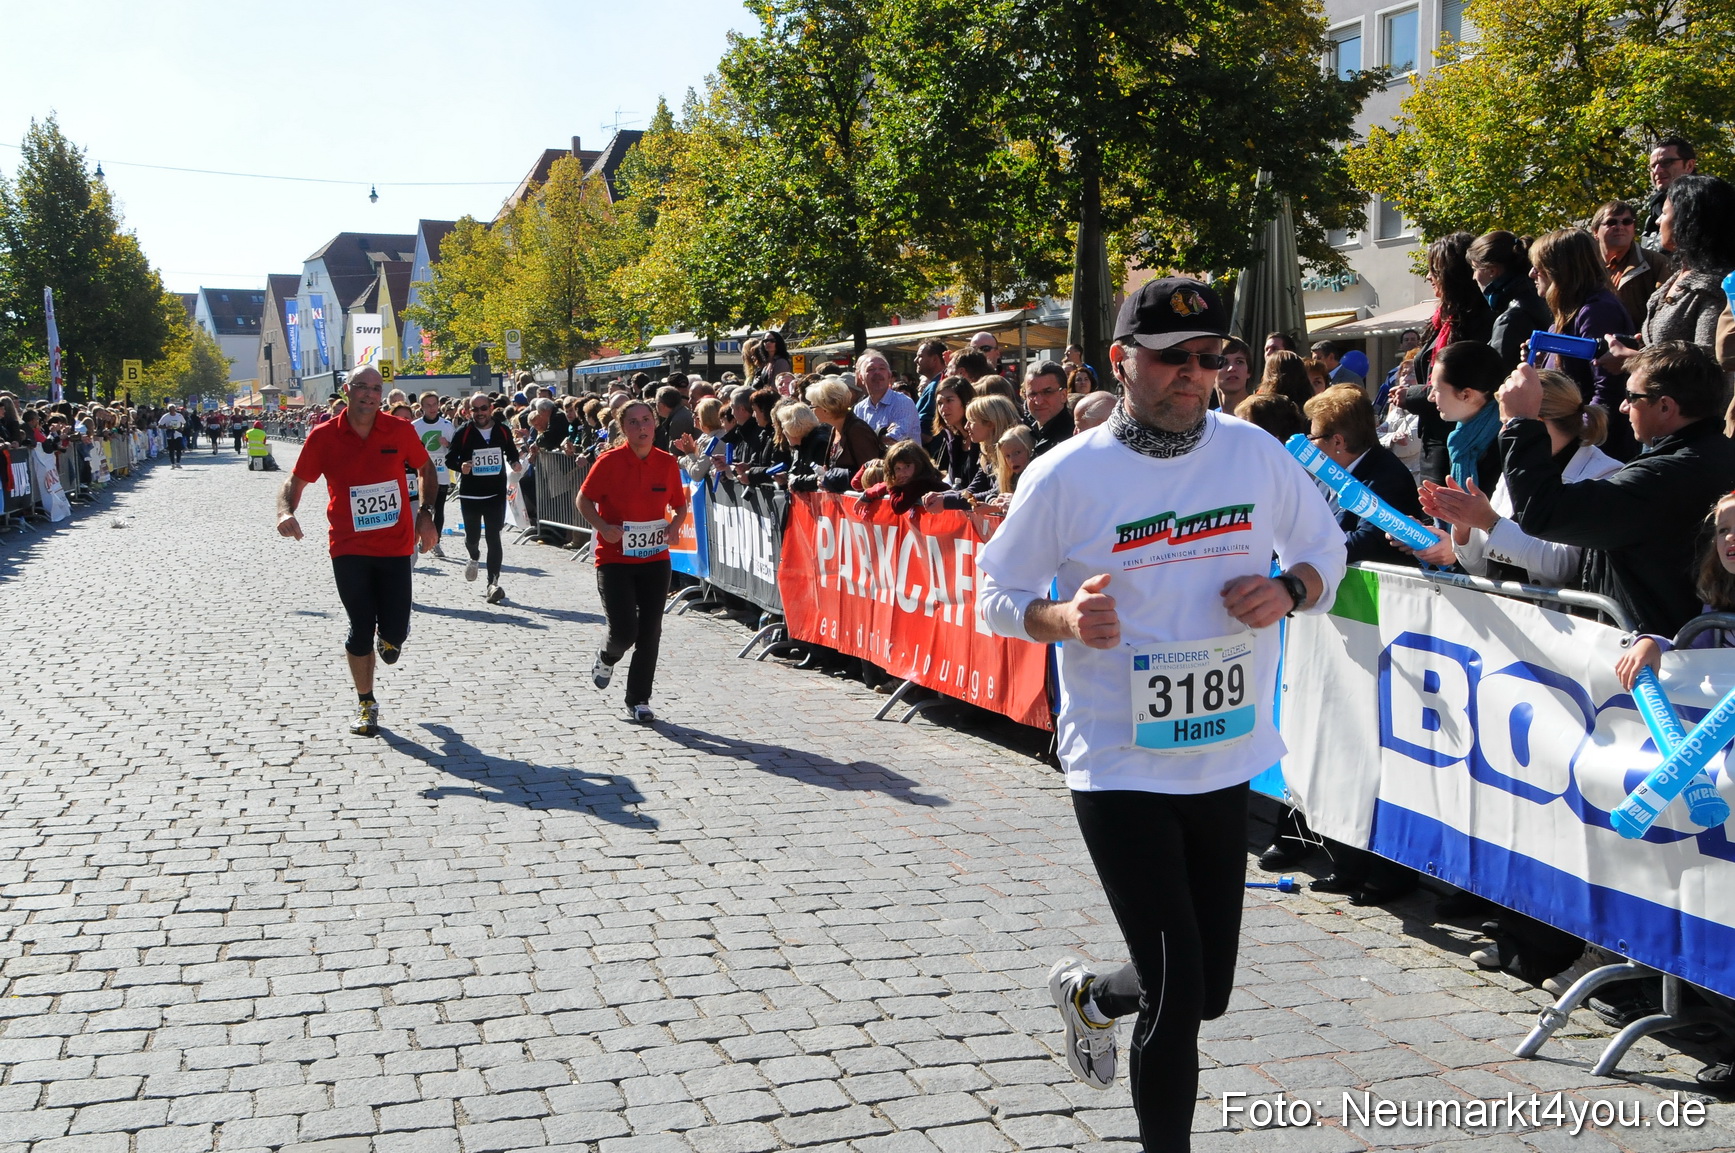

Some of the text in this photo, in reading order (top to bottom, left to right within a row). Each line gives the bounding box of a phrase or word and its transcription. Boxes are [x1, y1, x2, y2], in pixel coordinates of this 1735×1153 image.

[356, 326, 381, 334] swn
[128, 367, 138, 380] B
[381, 366, 391, 379] B
[434, 458, 443, 467] 42
[475, 455, 500, 467] 3165
[356, 493, 397, 515] 3254
[357, 516, 381, 526] Hans
[1175, 507, 1249, 539] ITALIA
[628, 530, 664, 549] 3348
[713, 502, 775, 585] THULE
[1123, 544, 1250, 567] FEINE ITALIENISCHE SPEZIALITÄTEN
[1151, 650, 1210, 664] PFLEIDERER
[912, 644, 995, 699] lounge
[1151, 661, 1210, 670] AKTIENGESELLSCHAFT
[1148, 663, 1245, 718] 3189
[1173, 718, 1226, 742] Hans
